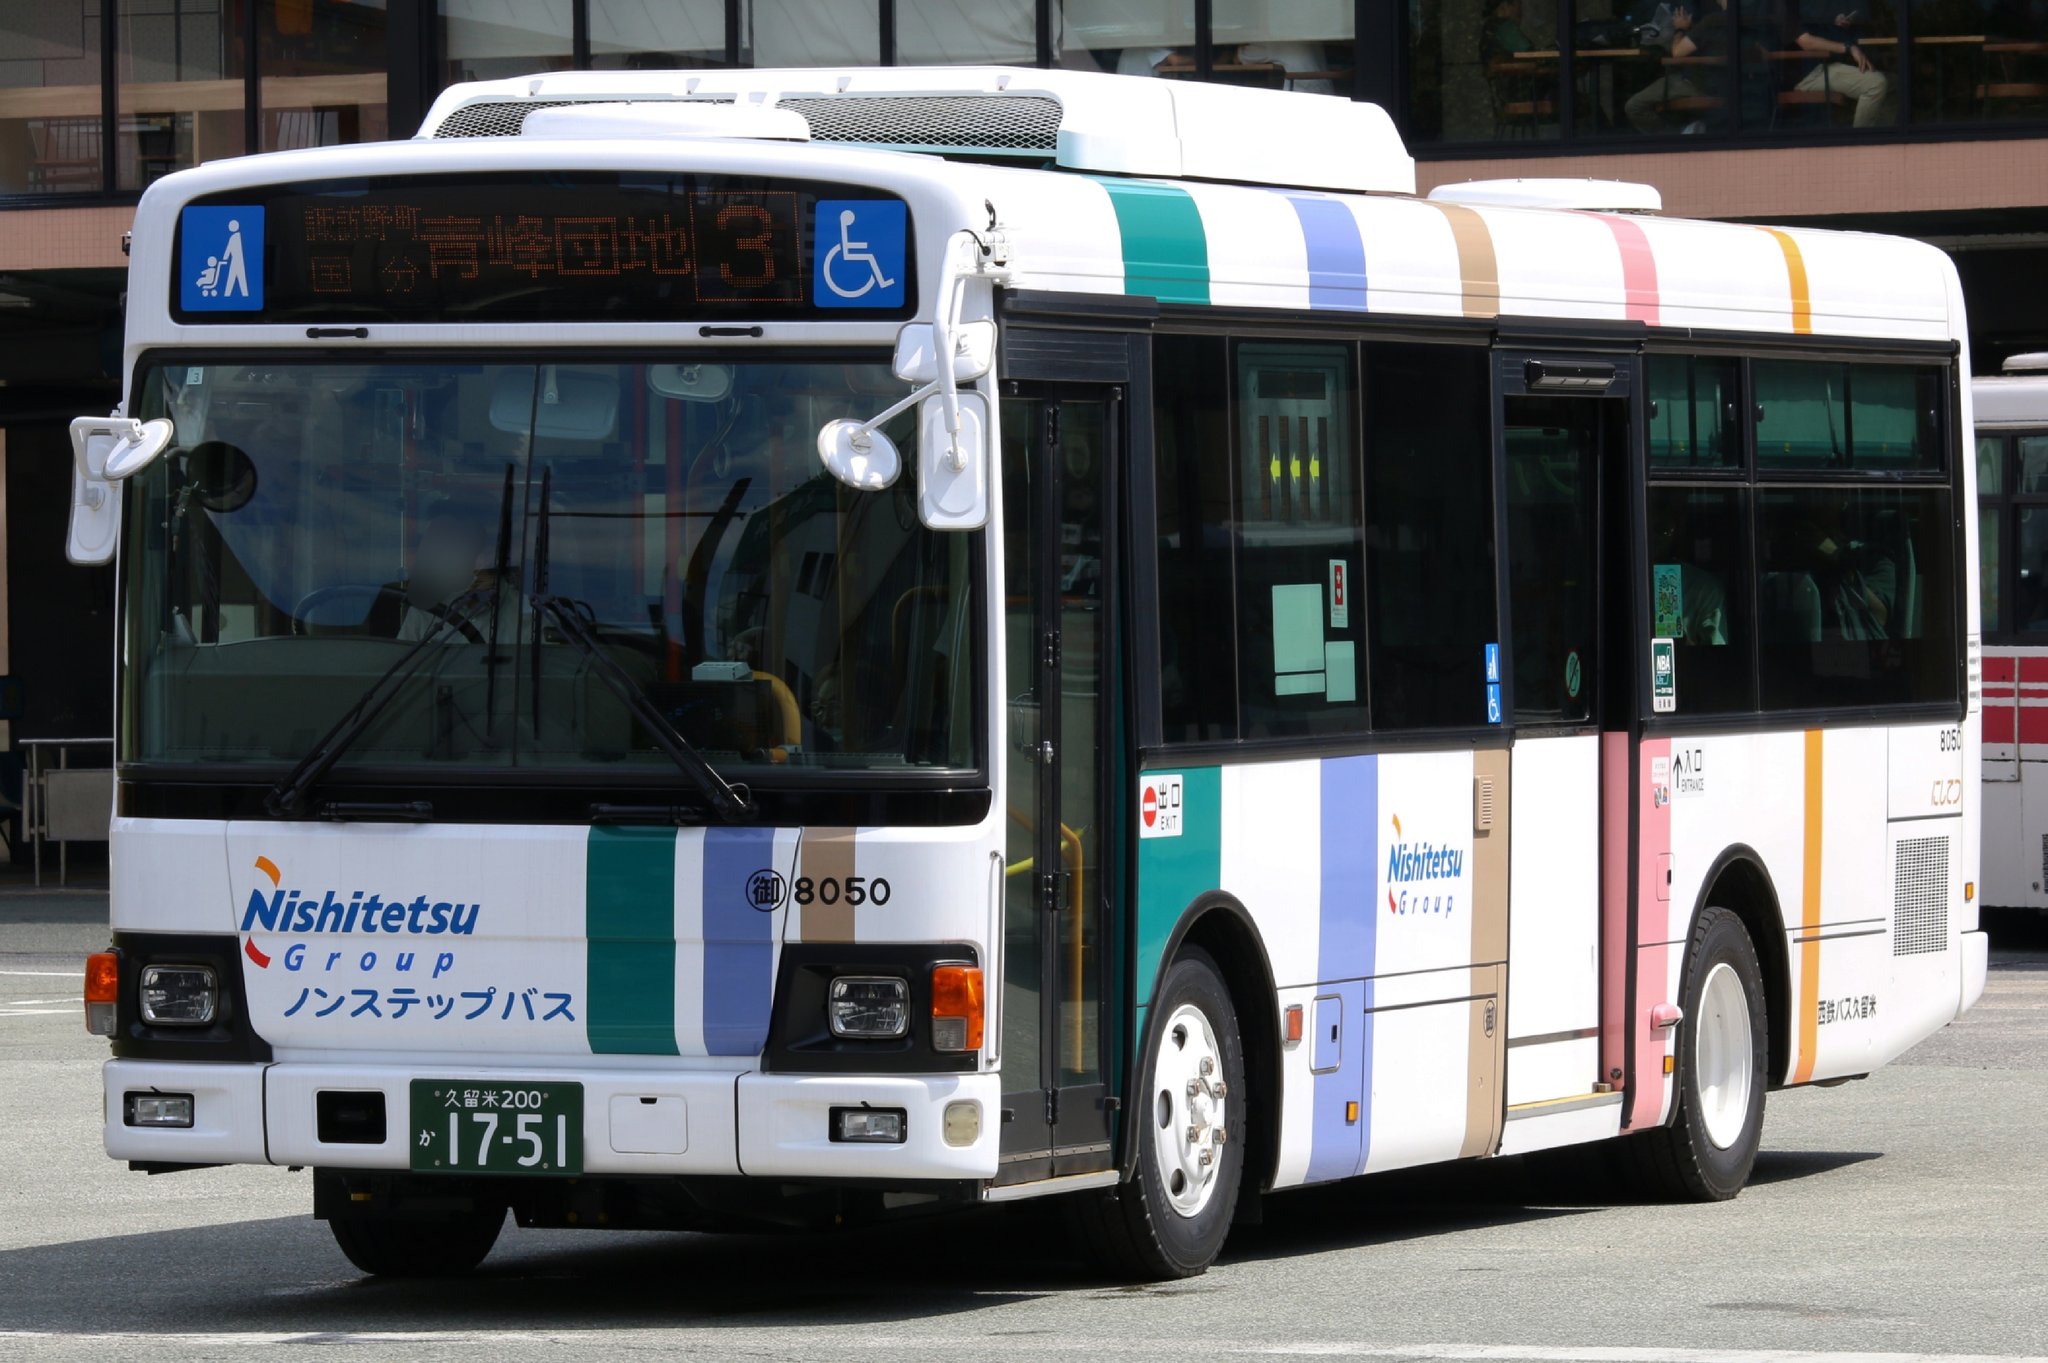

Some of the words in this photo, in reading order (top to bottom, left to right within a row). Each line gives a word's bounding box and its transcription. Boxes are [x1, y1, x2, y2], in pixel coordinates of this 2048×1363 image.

[420, 213, 692, 279] 青峰団地
[715, 204, 776, 288] 3
[1940, 728, 1962, 752] 8050
[1684, 749, 1702, 774] 入口
[1158, 782, 1180, 809] 出口
[1681, 777, 1704, 793] ENTRANCE
[1931, 779, 1961, 806] にしてつ
[1161, 815, 1177, 830] EXIT
[1387, 842, 1463, 883] Nishitetsu
[794, 877, 891, 906] 8050
[1399, 890, 1453, 919] Group
[240, 888, 480, 935] Nishitetsu
[284, 943, 454, 979] Group
[284, 985, 575, 1022] ノンステップバス
[1818, 994, 1876, 1025] 西鉄バス久留米
[419, 1129, 436, 1147] か
[449, 1112, 566, 1168] 17-51
